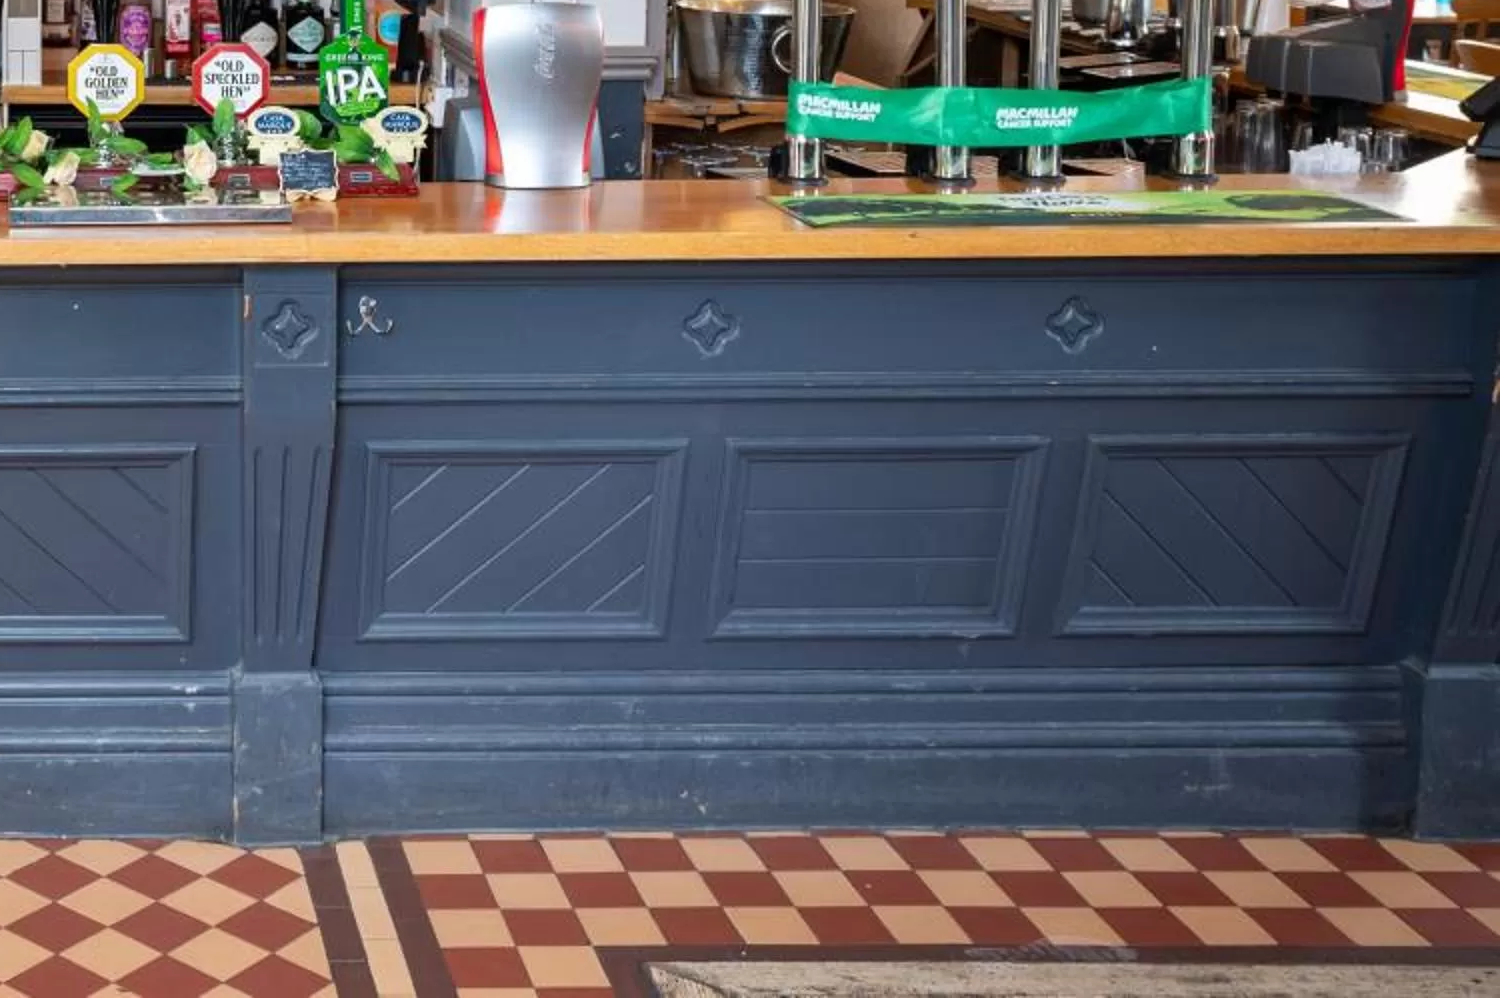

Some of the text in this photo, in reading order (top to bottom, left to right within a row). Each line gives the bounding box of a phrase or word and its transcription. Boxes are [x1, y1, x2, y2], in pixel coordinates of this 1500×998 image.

[85, 77, 128, 89] GOLDEN
[204, 72, 260, 85] SPECKLED
[325, 65, 388, 108] IPA
[797, 93, 882, 115] MACMILLAN
[835, 109, 876, 122] SUPPORT
[996, 106, 1079, 120] MACMILLAN
[1033, 118, 1073, 129] SUPPORT
